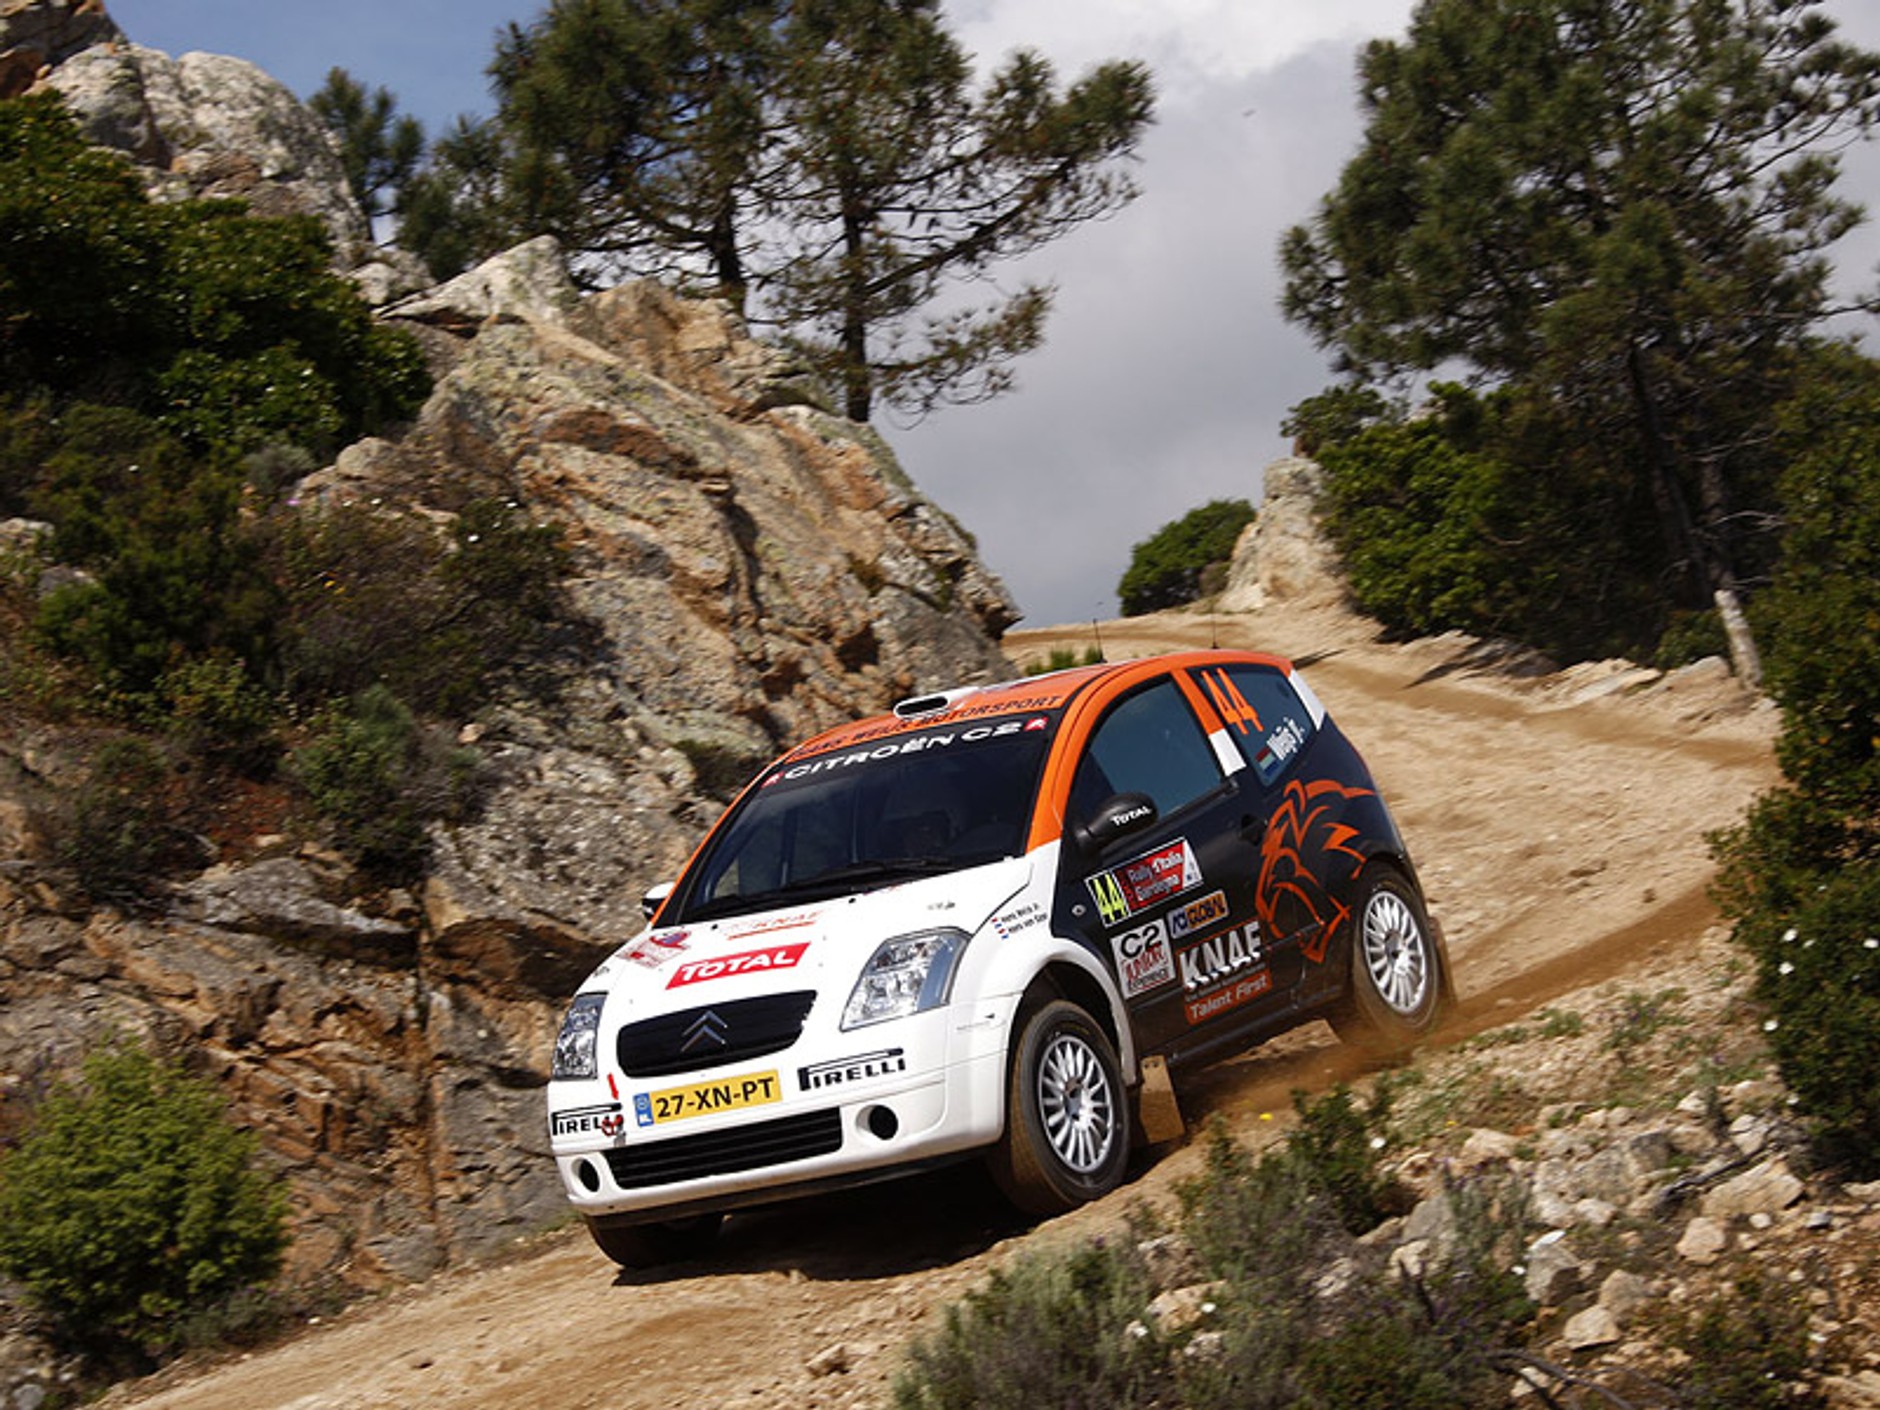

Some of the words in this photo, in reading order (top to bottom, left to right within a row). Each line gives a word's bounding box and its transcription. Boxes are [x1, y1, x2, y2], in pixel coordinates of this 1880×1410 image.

[1201, 667, 1264, 735] 44
[961, 719, 1023, 742] C2
[1110, 805, 1152, 827] TOTAL
[1093, 872, 1127, 923] 44
[1120, 924, 1163, 958] C2
[1179, 920, 1262, 990] KNAF
[680, 949, 796, 982] TOTAL
[1190, 990, 1233, 1020] Talent
[1235, 974, 1268, 1001] First
[797, 1047, 906, 1092] PIRELLI
[655, 1077, 775, 1119] 27-XN-PT
